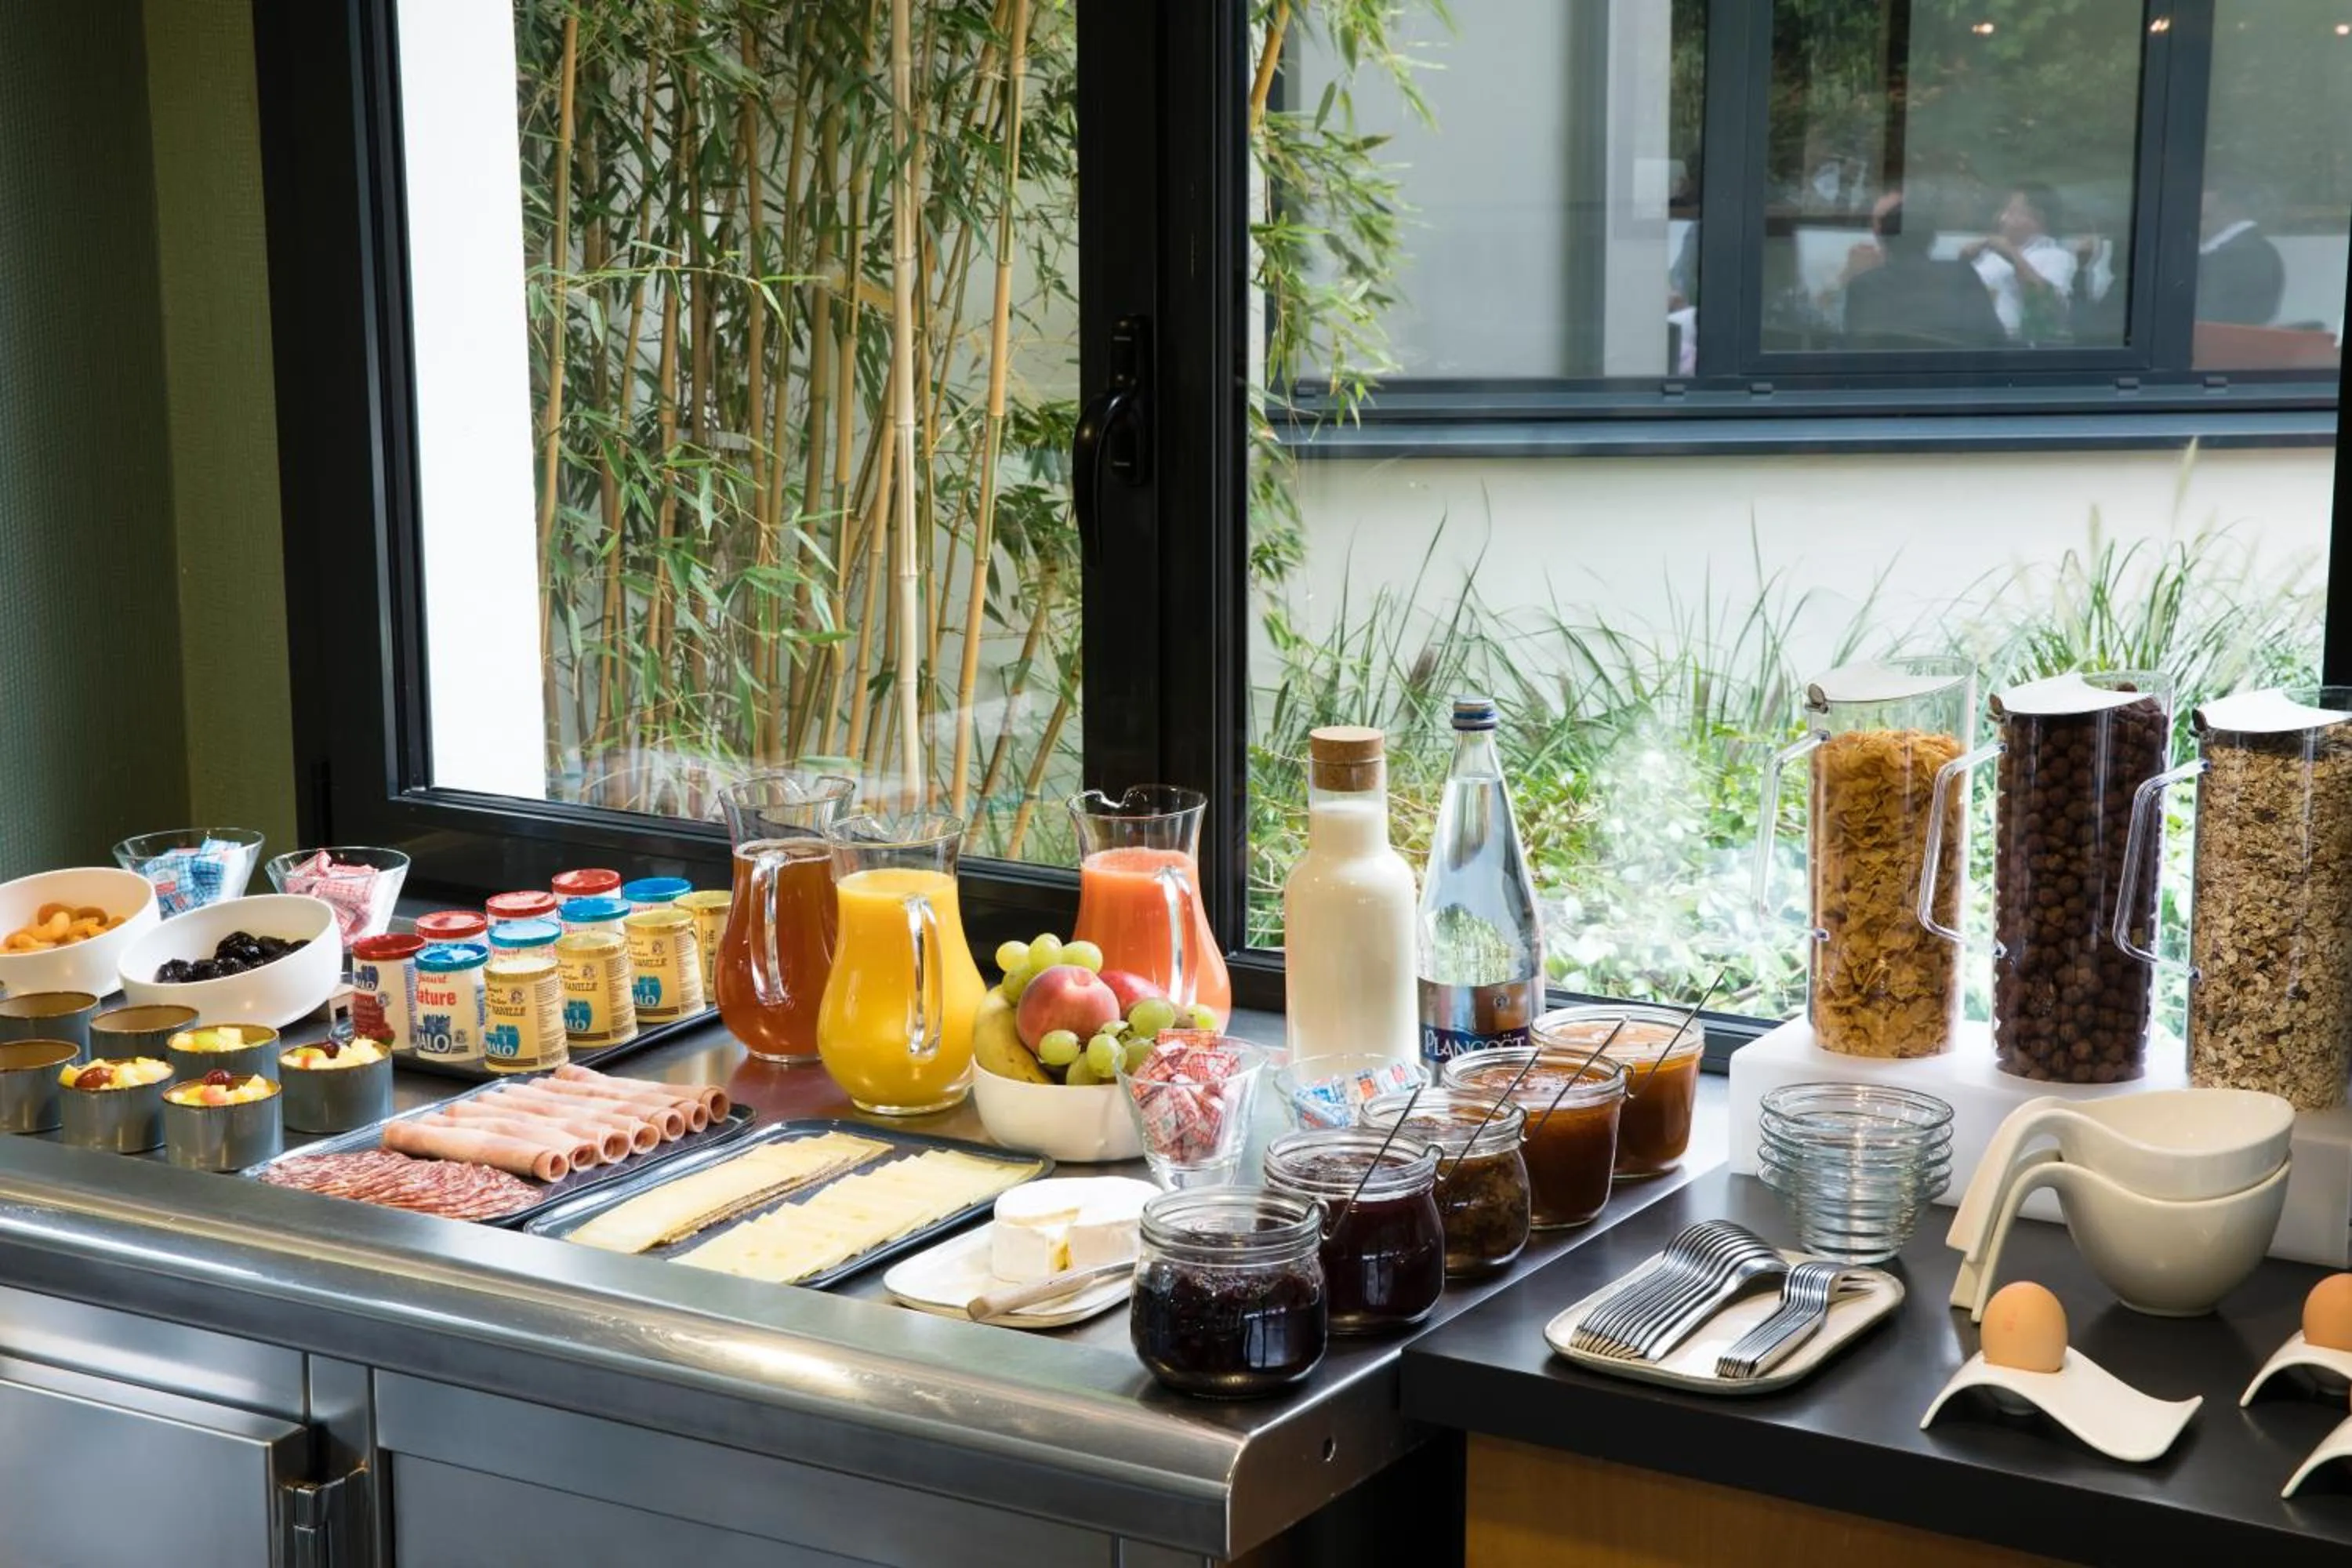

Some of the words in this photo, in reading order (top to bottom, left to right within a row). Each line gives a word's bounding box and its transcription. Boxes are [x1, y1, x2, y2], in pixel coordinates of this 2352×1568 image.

[355, 978, 376, 989] ALO
[416, 988, 456, 1006] ature
[632, 993, 657, 1006] ALO
[564, 1018, 586, 1031] ALO
